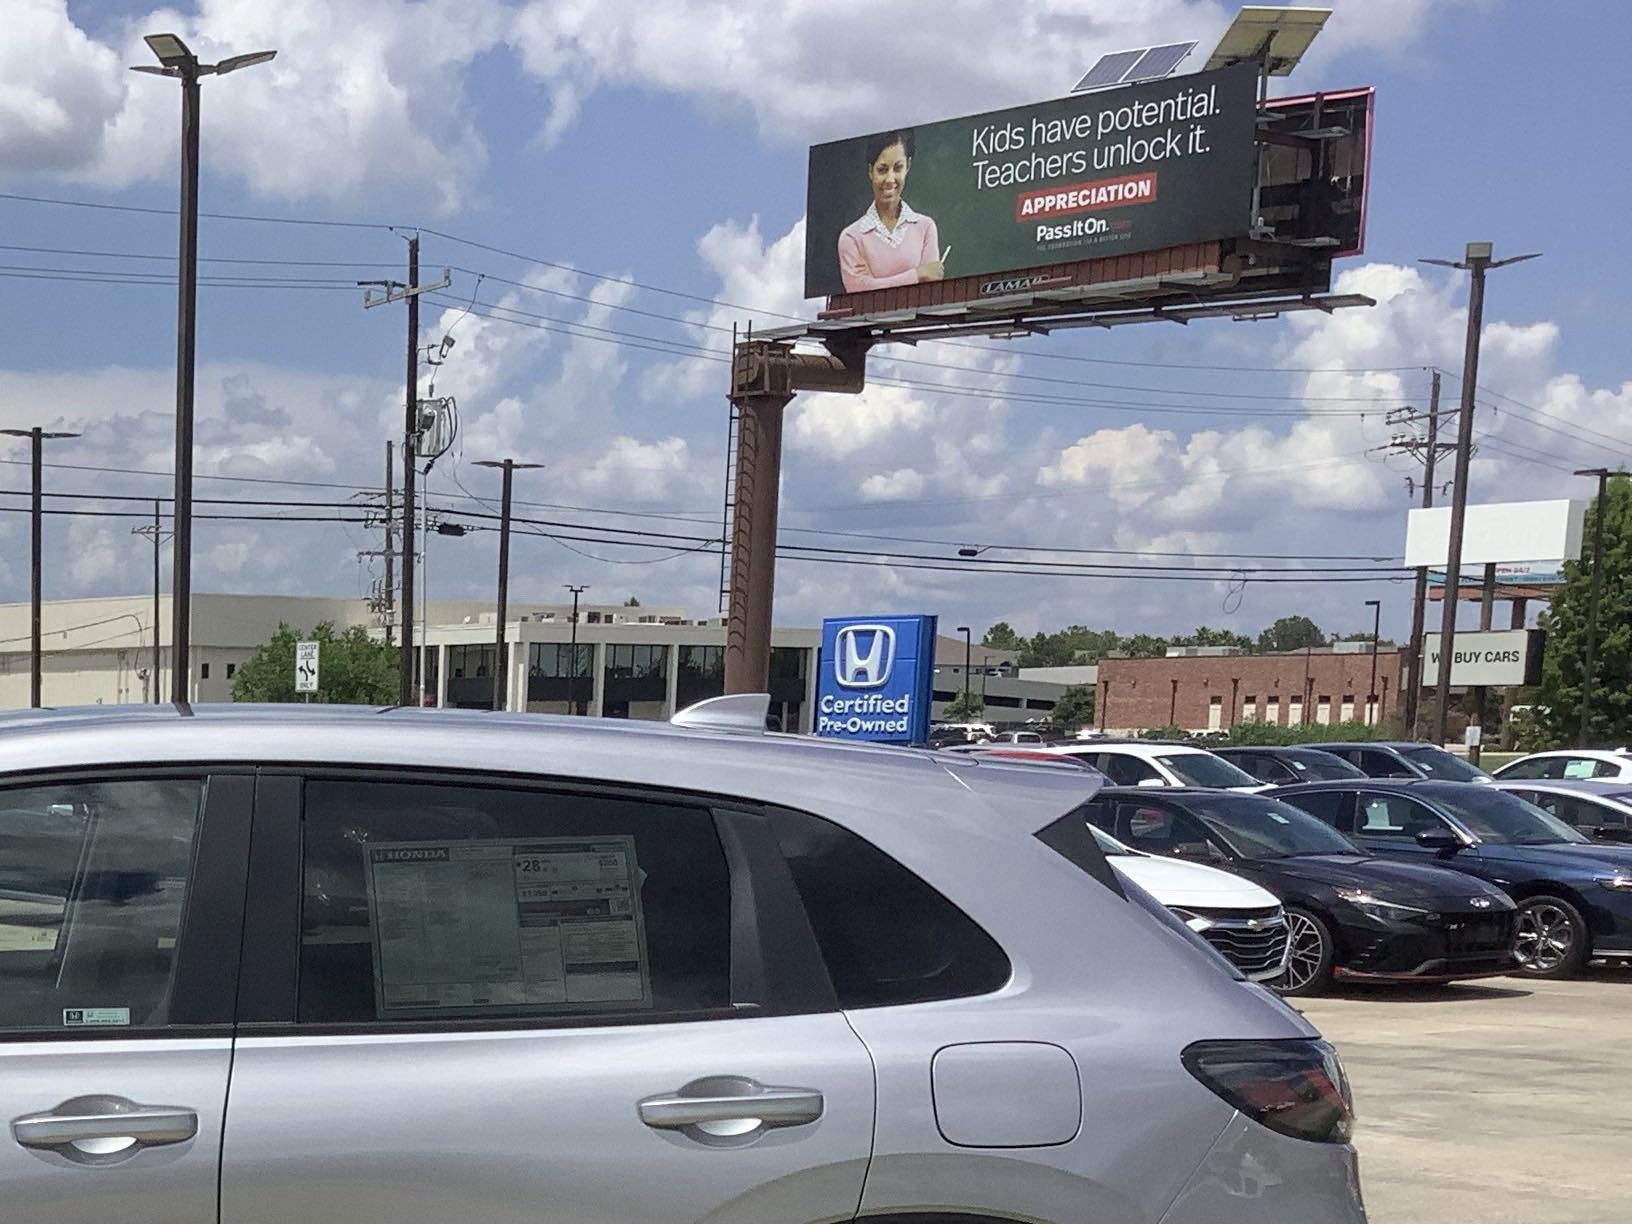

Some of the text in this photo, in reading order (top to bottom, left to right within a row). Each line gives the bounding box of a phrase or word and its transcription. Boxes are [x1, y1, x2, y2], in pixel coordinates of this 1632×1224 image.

[972, 85, 1221, 156] Kids have potential.
[973, 124, 1211, 190] Teachers unlock it.
[1021, 179, 1152, 216] APPRECIATION
[1454, 652, 1481, 664] BUY
[1484, 651, 1520, 663] CARS
[821, 694, 910, 714] Certified
[819, 716, 909, 733] Pre-Owned
[386, 850, 447, 860] HONDA
